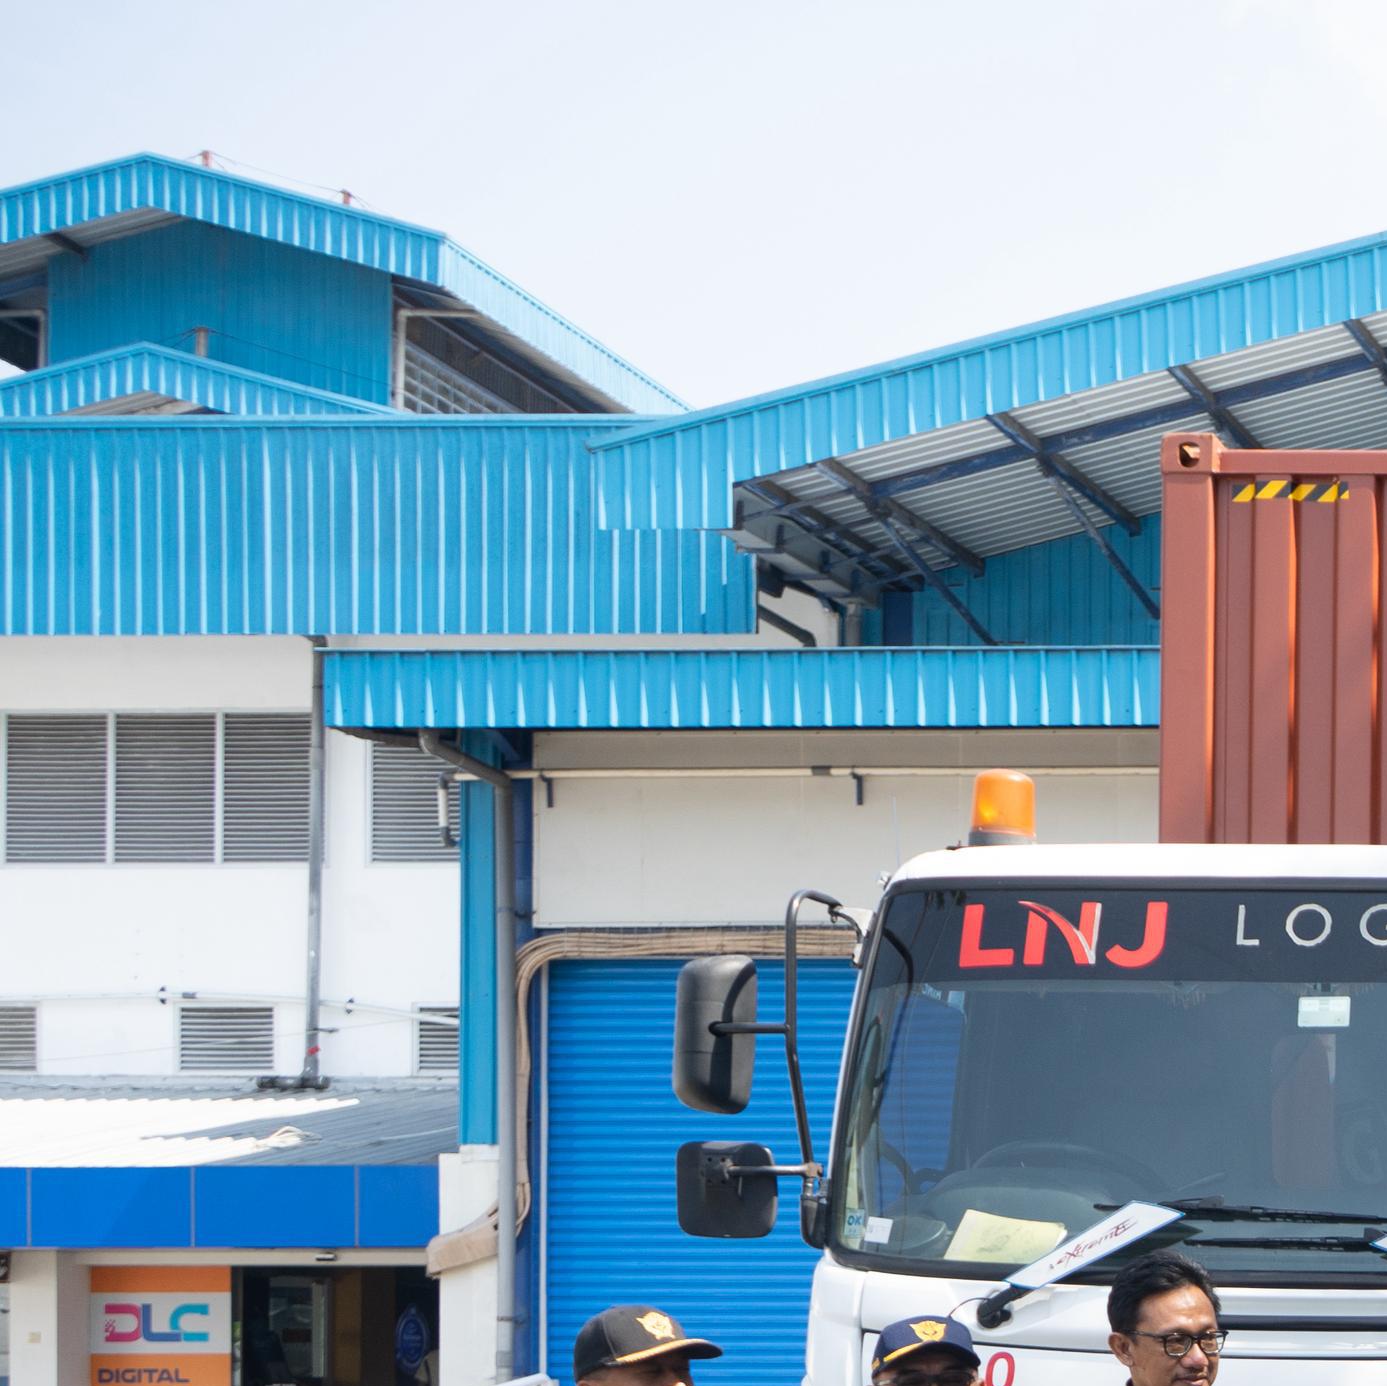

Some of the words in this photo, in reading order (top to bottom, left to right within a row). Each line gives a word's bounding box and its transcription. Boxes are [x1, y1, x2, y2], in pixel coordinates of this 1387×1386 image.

[960, 901, 1168, 968] LNJ
[104, 1303, 209, 1342] DLC
[97, 1368, 190, 1383] DIGITAL
